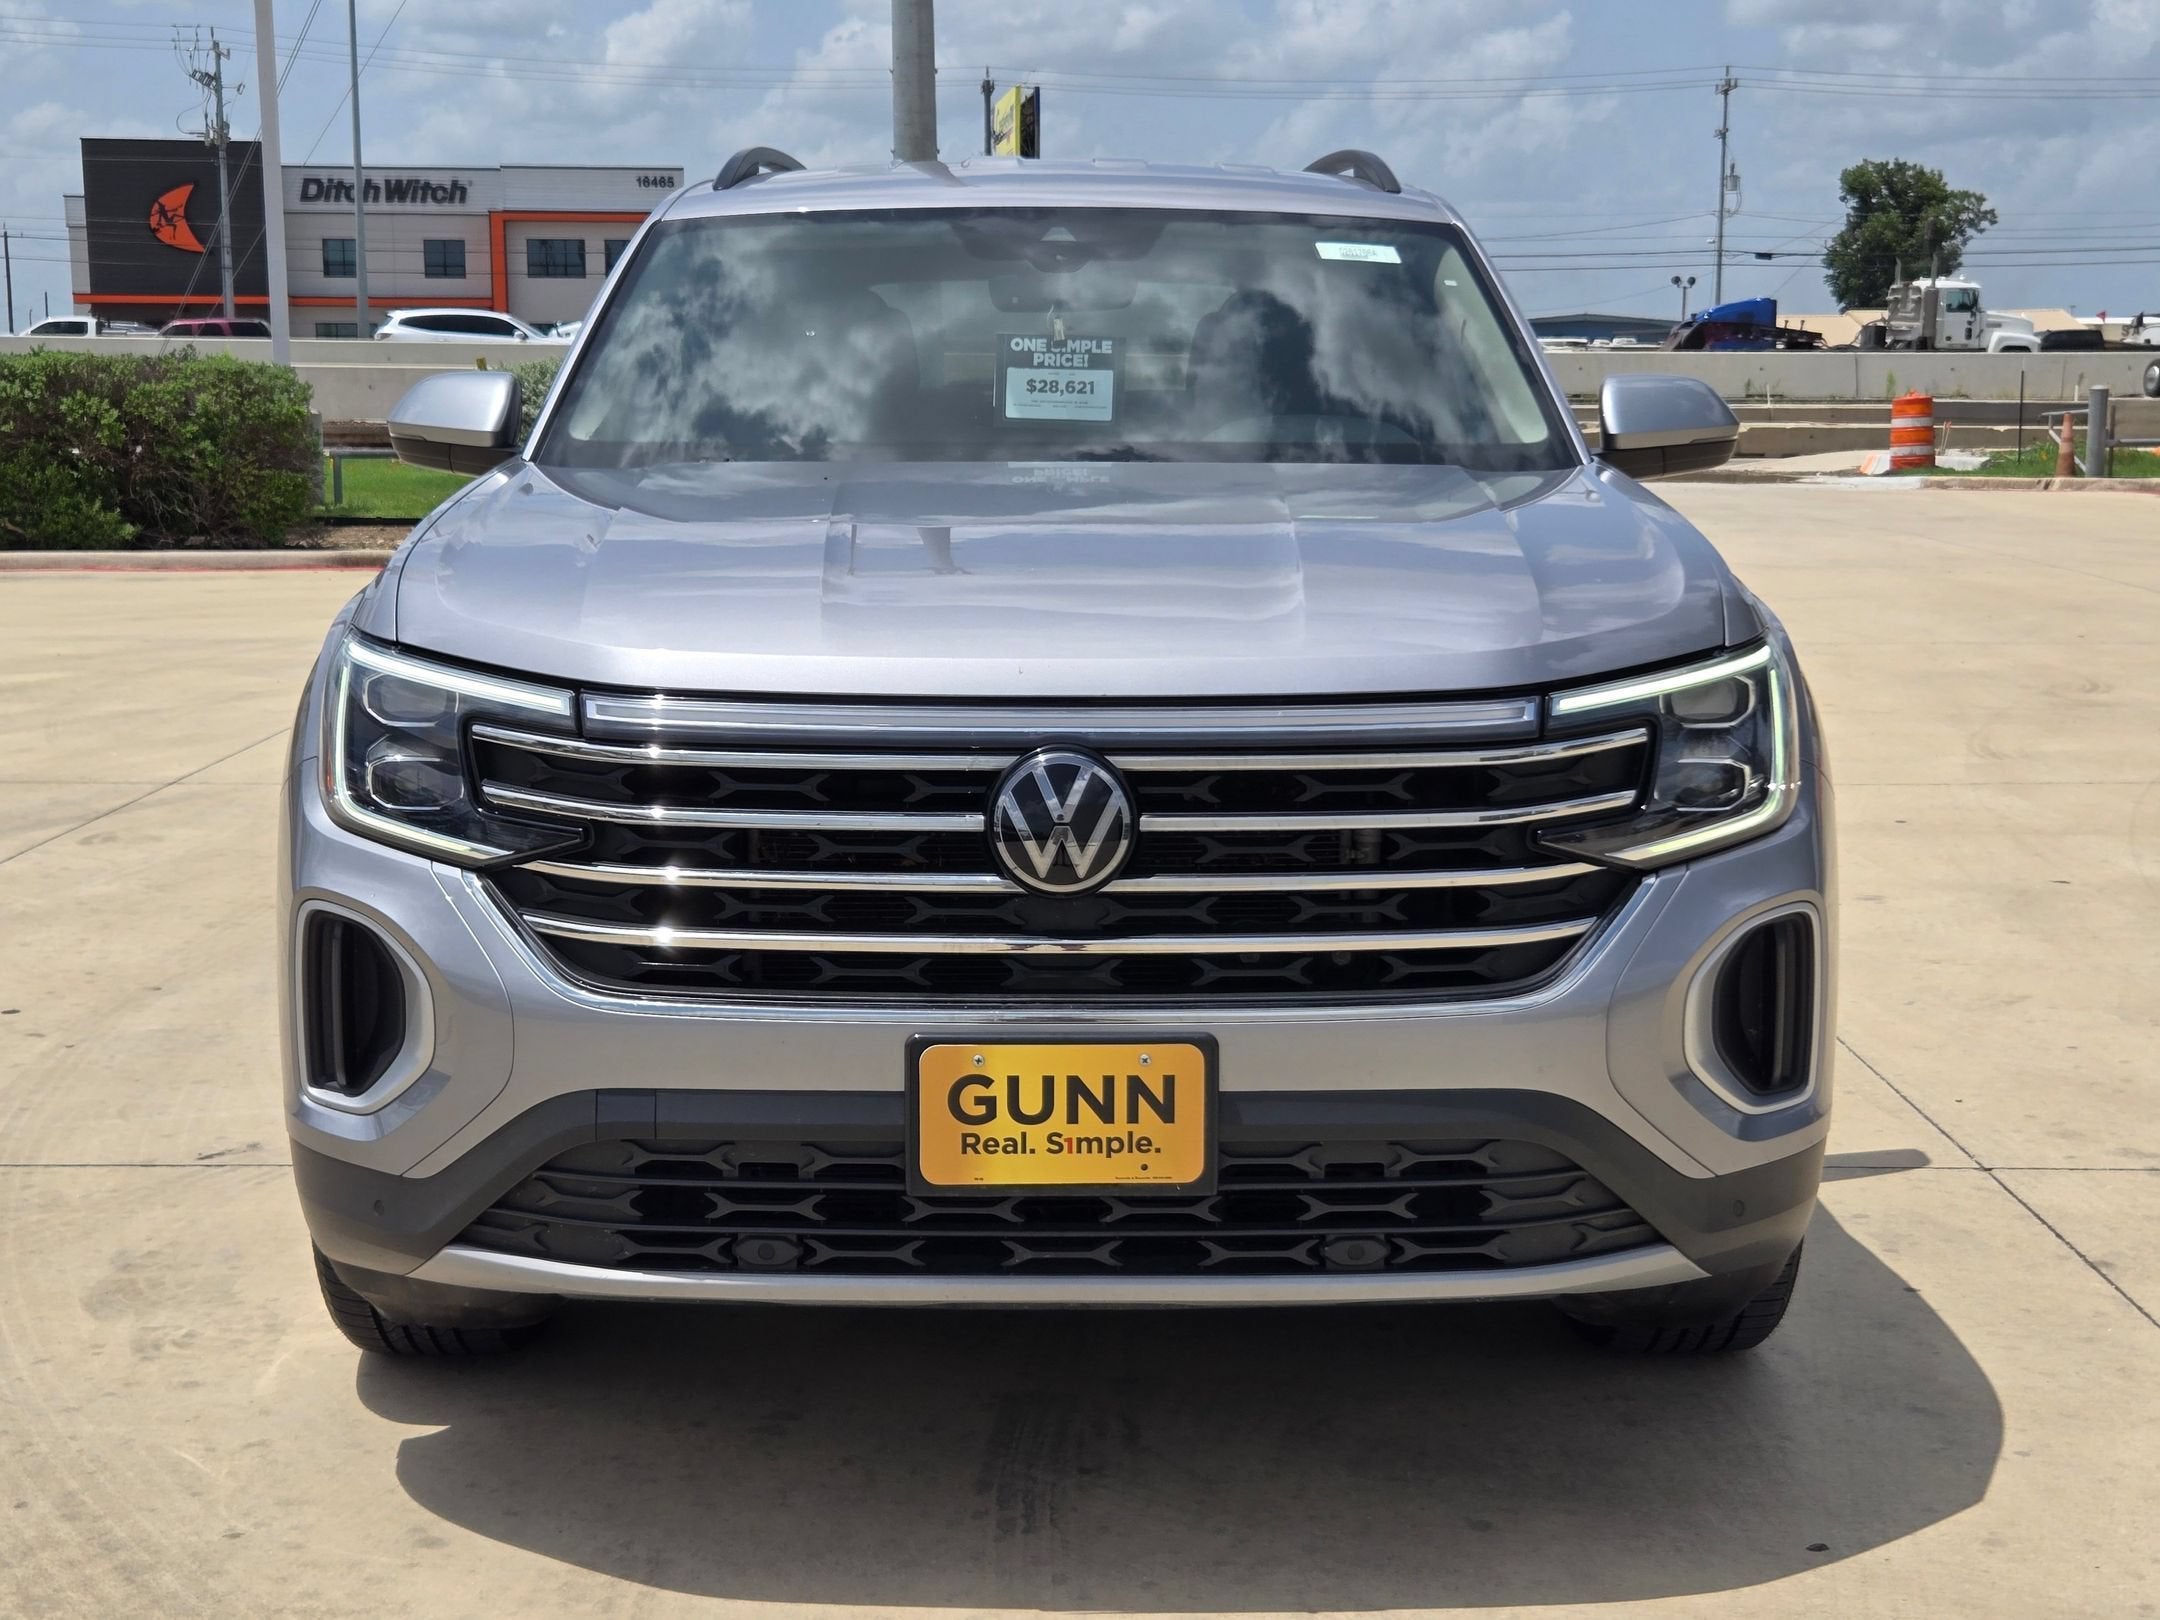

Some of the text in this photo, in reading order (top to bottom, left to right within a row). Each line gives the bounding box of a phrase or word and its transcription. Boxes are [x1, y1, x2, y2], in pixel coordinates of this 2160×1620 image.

[300, 178, 468, 204] Ditch Witch
[636, 176, 675, 188] 16465
[1010, 338, 1048, 352] ONE
[1033, 353, 1089, 368] PRICE!
[1026, 378, 1095, 397] $28,621
[947, 1074, 1176, 1126] GUNN
[960, 1132, 1036, 1155] Real.
